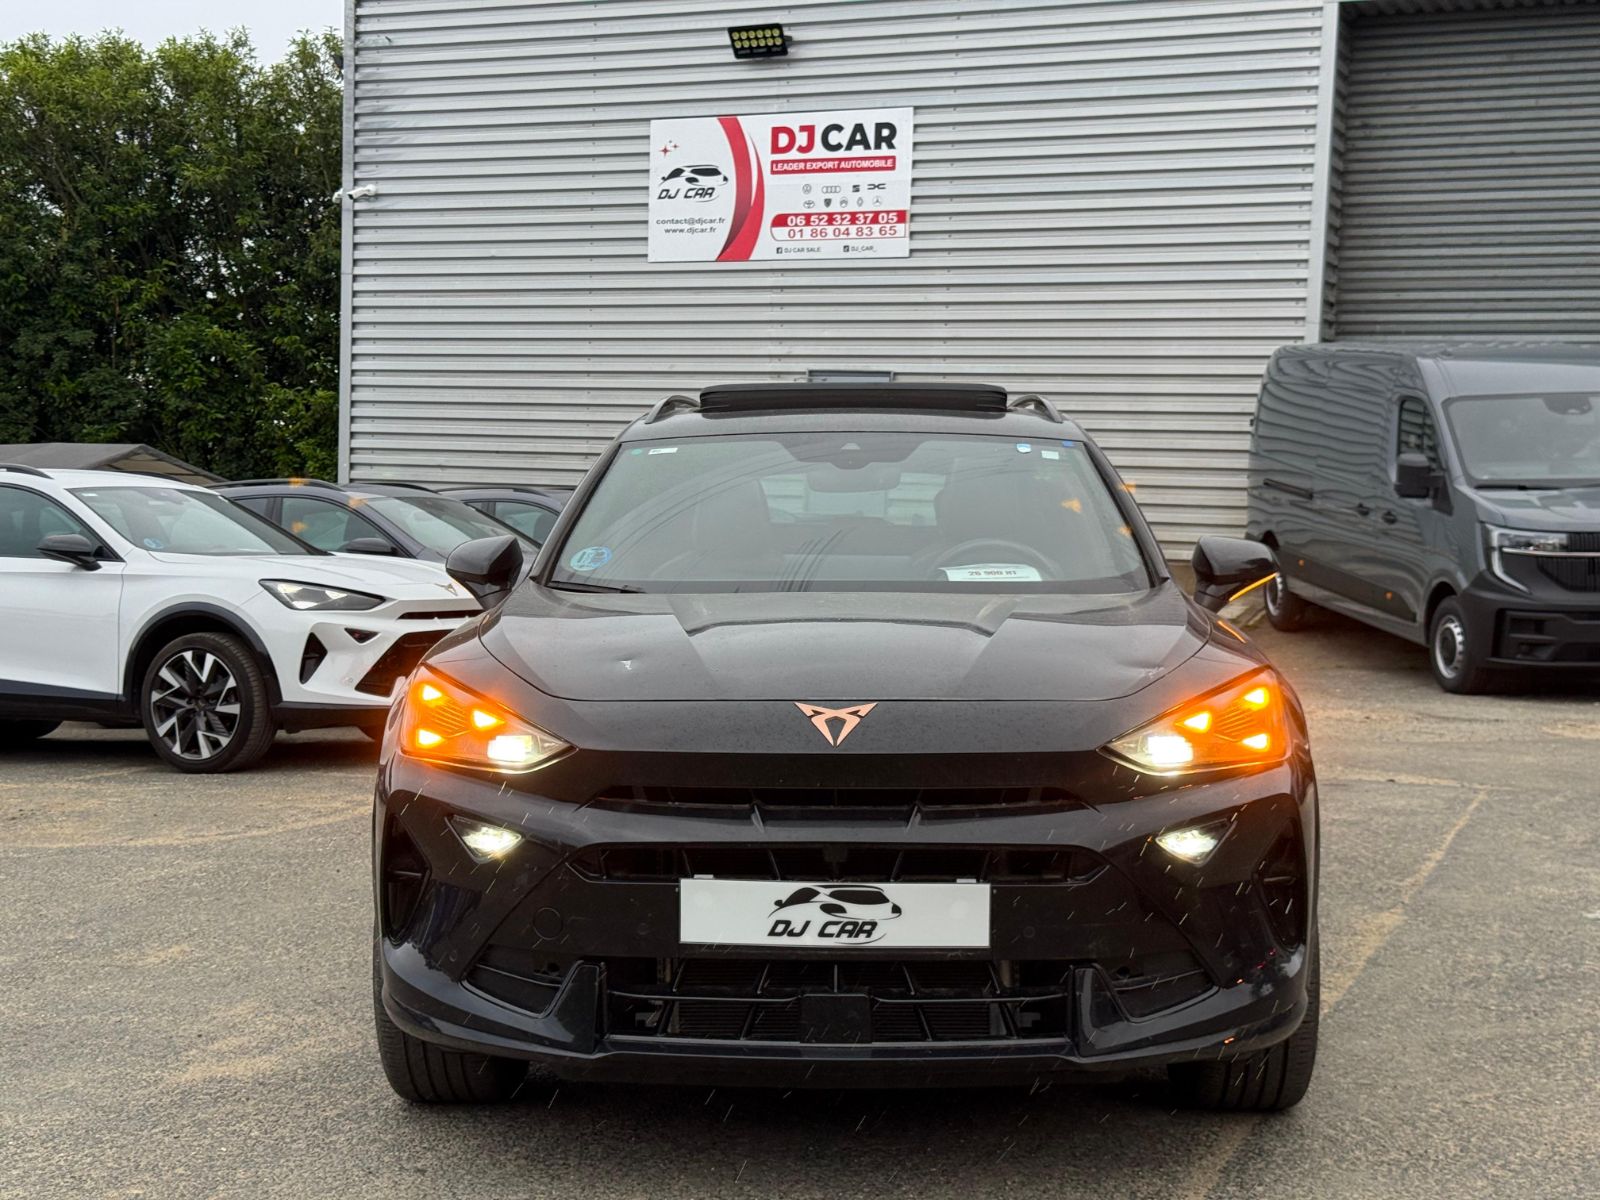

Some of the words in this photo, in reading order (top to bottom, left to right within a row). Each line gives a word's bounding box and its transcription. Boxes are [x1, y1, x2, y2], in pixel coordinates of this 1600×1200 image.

[770, 124, 816, 155] DJ
[821, 122, 898, 152] CAR
[772, 161, 806, 171] LEADER
[806, 160, 839, 170] EXPORT
[839, 158, 894, 169] AUTOMOBILE
[657, 188, 681, 200] DJ
[683, 187, 716, 199] CAR
[656, 217, 726, 226] contact@djcar.fr
[787, 215, 806, 226] 06
[810, 215, 829, 226] 52
[832, 214, 852, 225] 32
[855, 213, 875, 224] 37
[878, 212, 898, 223] 05
[664, 226, 718, 234] www.djcar.fr
[787, 228, 804, 239] 01
[810, 227, 828, 238] 86
[832, 227, 851, 238] 04
[855, 226, 874, 237] 83
[878, 225, 897, 236] 65
[767, 919, 811, 937] DJ
[817, 920, 878, 938] CAR
